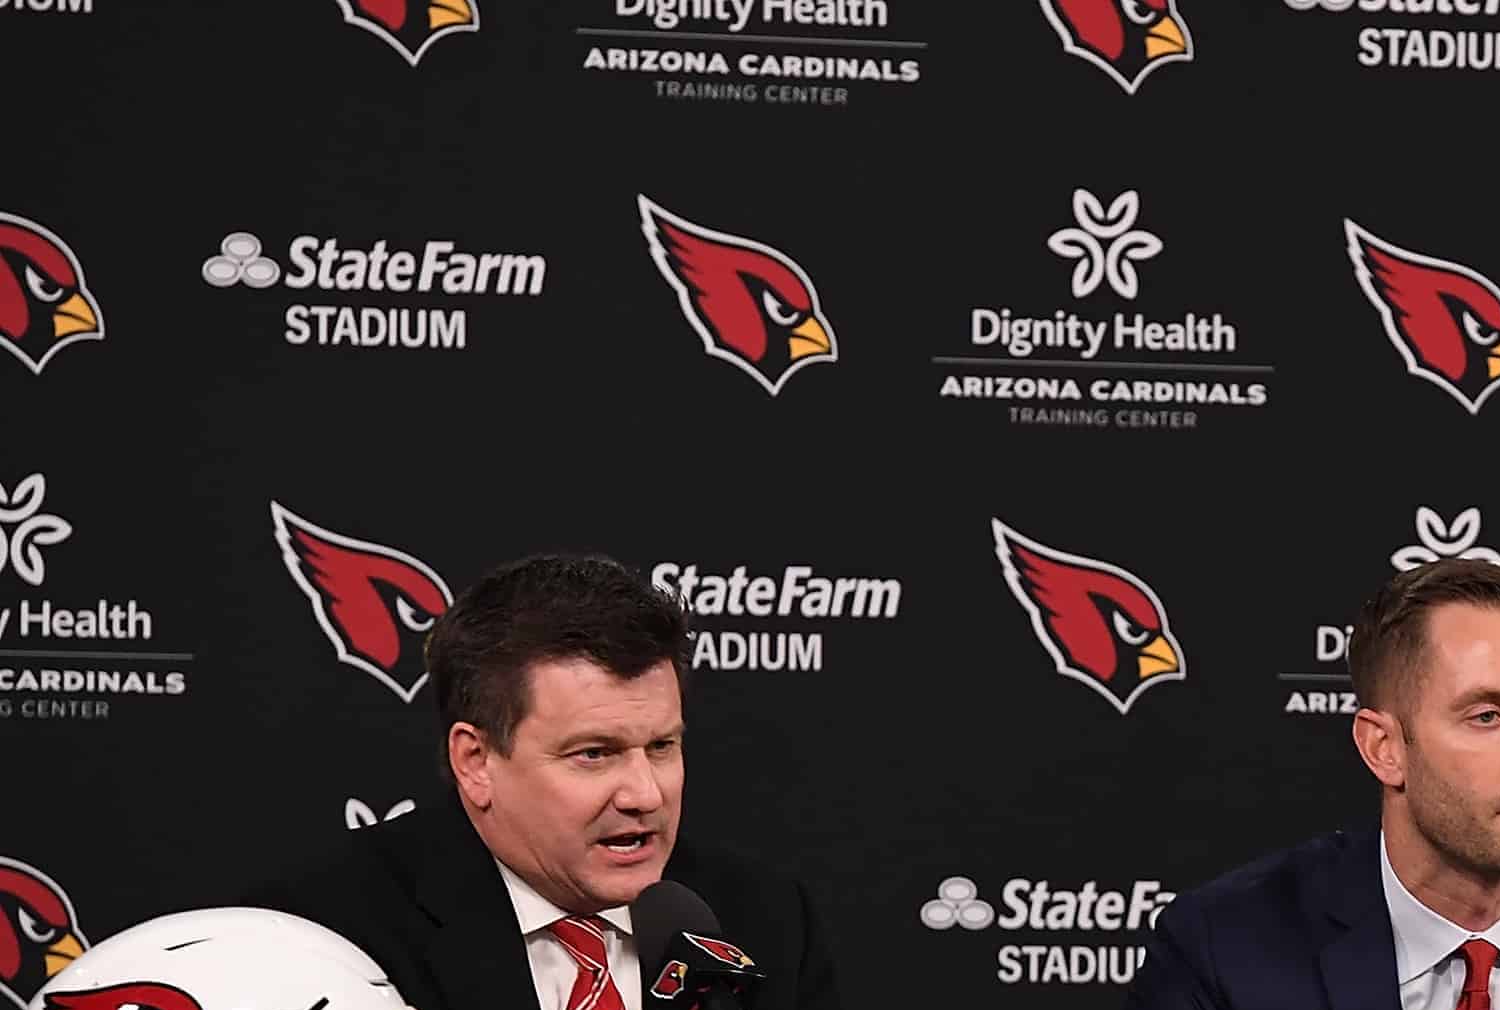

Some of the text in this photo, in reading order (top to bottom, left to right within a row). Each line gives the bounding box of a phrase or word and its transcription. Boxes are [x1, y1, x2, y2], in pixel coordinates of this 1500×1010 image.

[763, 0, 888, 27] Health
[583, 47, 920, 82] ARIZONA CARDINALS
[656, 80, 849, 105] TRAINING CENTER
[285, 304, 466, 349] STADIUM
[972, 308, 1236, 359] Dignity Health
[940, 375, 1267, 405] ARIZONA CARDINALS
[1009, 407, 1197, 428] TRAINING CENTER
[20, 599, 152, 639] Health
[686, 631, 823, 671] ADIUM
[0, 669, 186, 694] CARDINALS
[21, 700, 109, 718] CENTER
[1285, 692, 1358, 714] ARIZ
[998, 877, 1177, 931] StateF
[997, 944, 1147, 985] STADIU
